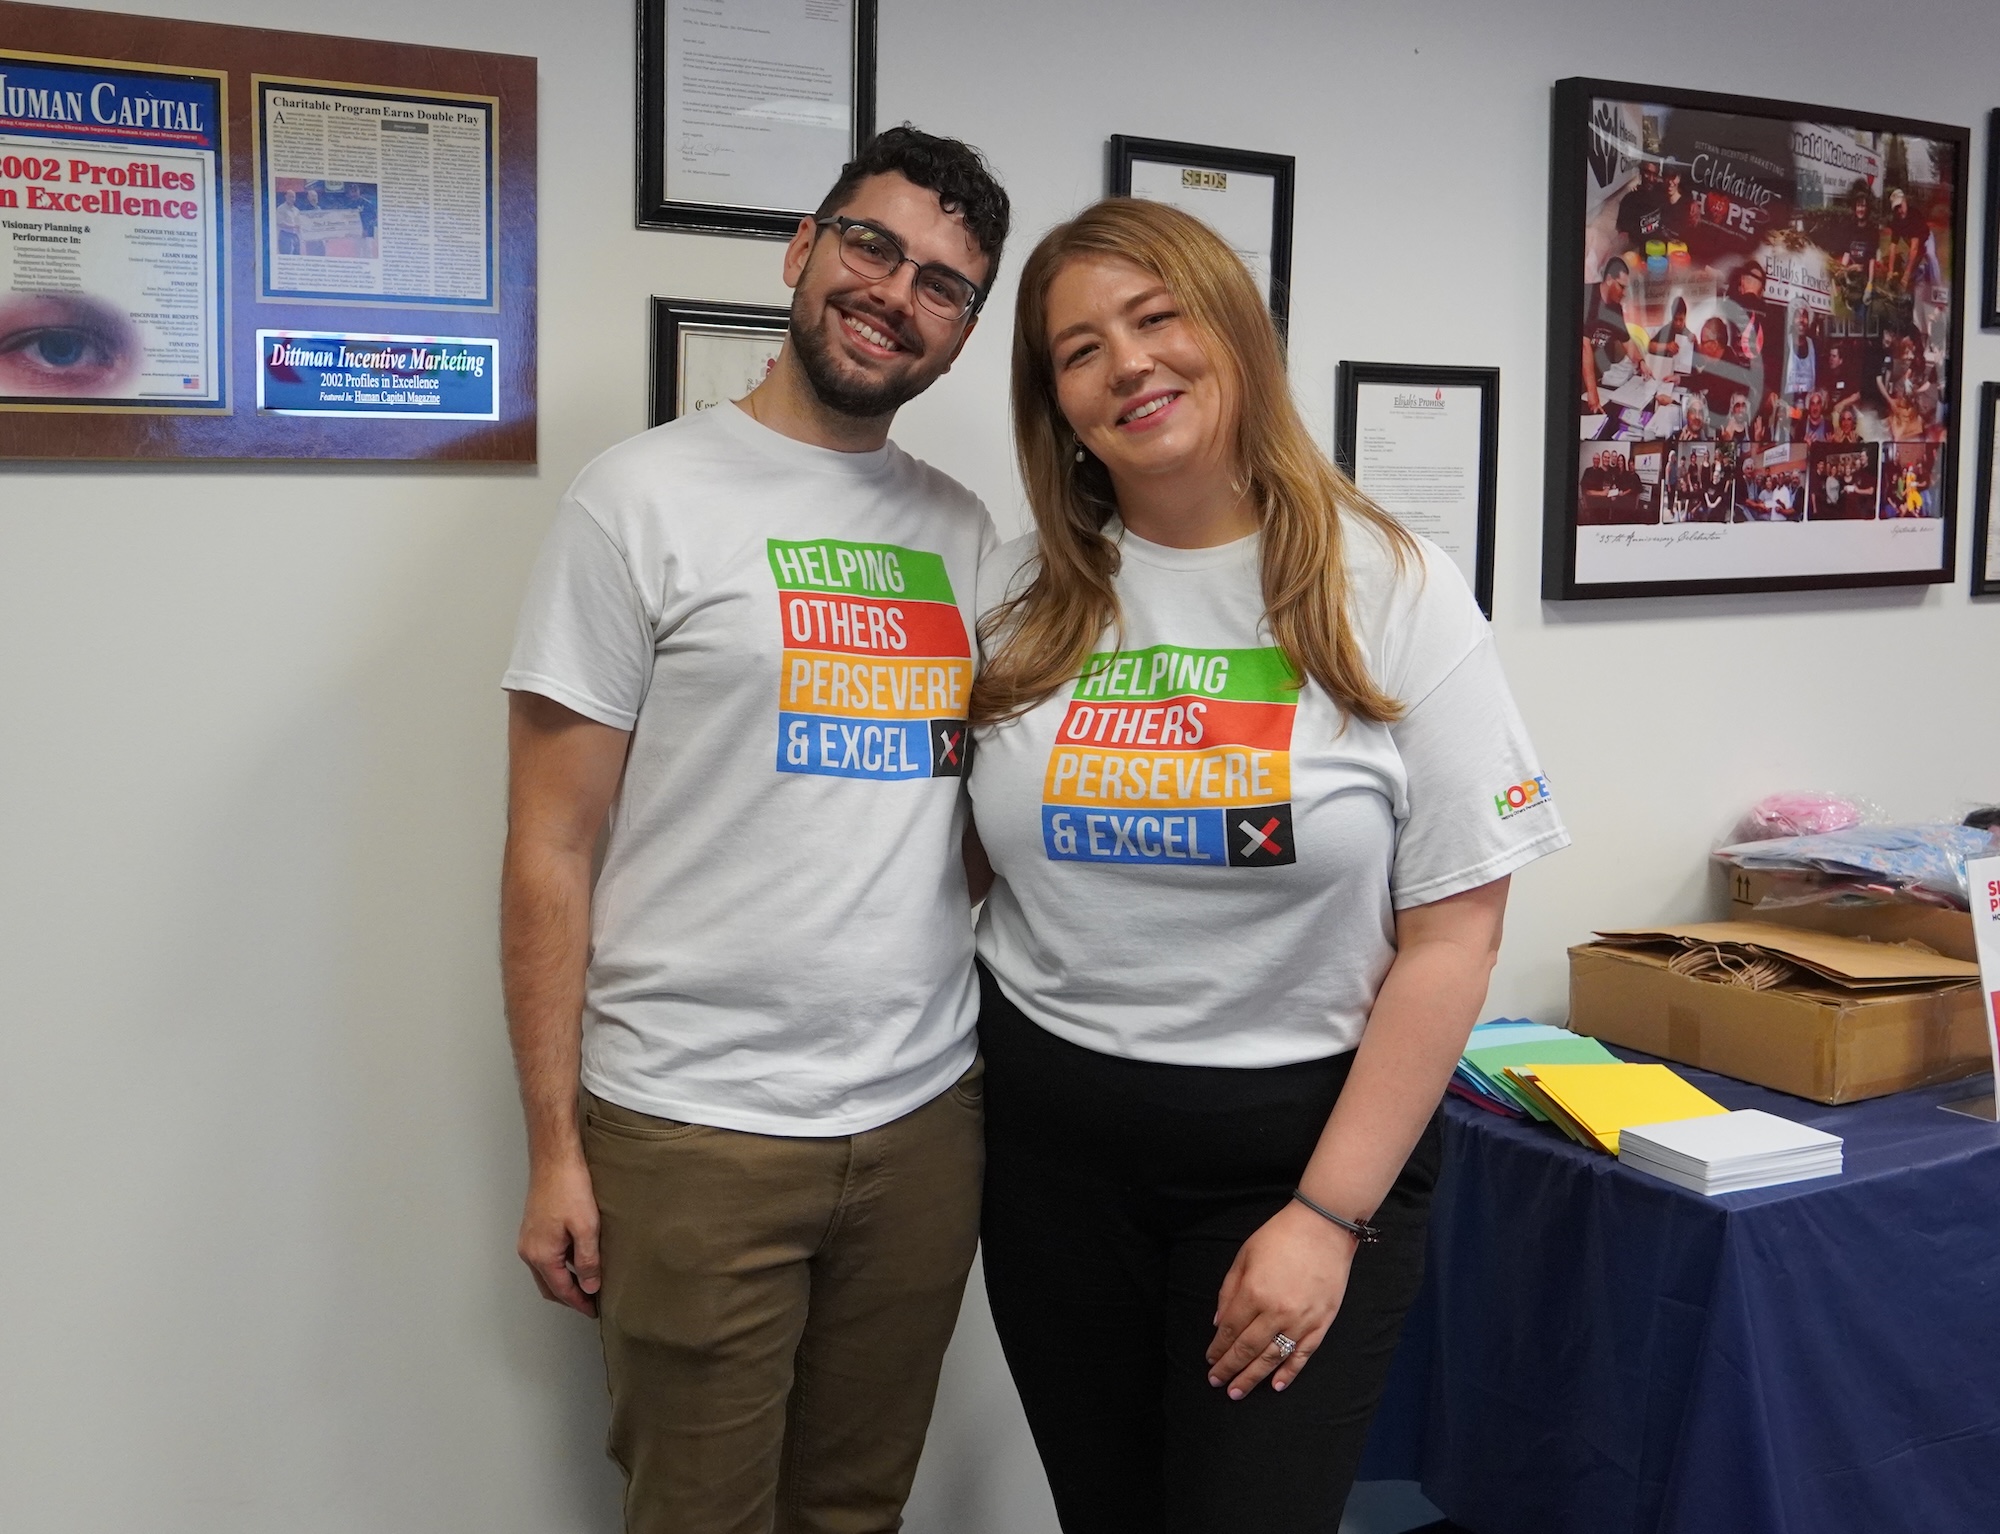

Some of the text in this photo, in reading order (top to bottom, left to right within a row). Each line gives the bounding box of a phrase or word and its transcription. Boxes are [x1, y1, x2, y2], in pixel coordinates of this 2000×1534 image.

[0, 73, 204, 132] UMAN CAPITAL
[273, 96, 480, 127] Charitable Program Earns Double Play
[0, 155, 196, 191] 002 Profiles
[1182, 169, 1227, 189] SEEDS
[1690, 153, 1782, 212] Celebrating
[1750, 155, 1785, 177] MARKETING
[26, 186, 198, 220] Excellence
[2, 220, 91, 235] Visionary Planning &
[13, 232, 68, 243] Performance
[1765, 255, 1799, 284] Elijah's
[270, 343, 485, 378] Dittman Incentive Marketing
[319, 391, 344, 402] Featured
[354, 391, 380, 402] Human
[381, 392, 406, 404] Capital
[407, 392, 441, 405] Magazine
[320, 373, 439, 390] 2002 Profiles in Excellence
[775, 545, 905, 593] HELPING
[788, 598, 908, 650] OTHERS
[788, 658, 963, 711] PERSEVERE
[1083, 652, 1230, 697] HELPING
[1066, 702, 1208, 745] OTHERS
[786, 720, 809, 766] &
[820, 722, 919, 773] EXCEL
[1053, 752, 1273, 801] PERSEVERE
[1494, 775, 1550, 816] HOPE
[1051, 812, 1078, 855] &
[1086, 815, 1211, 860] EXCEL
[1990, 898, 2000, 912] P
